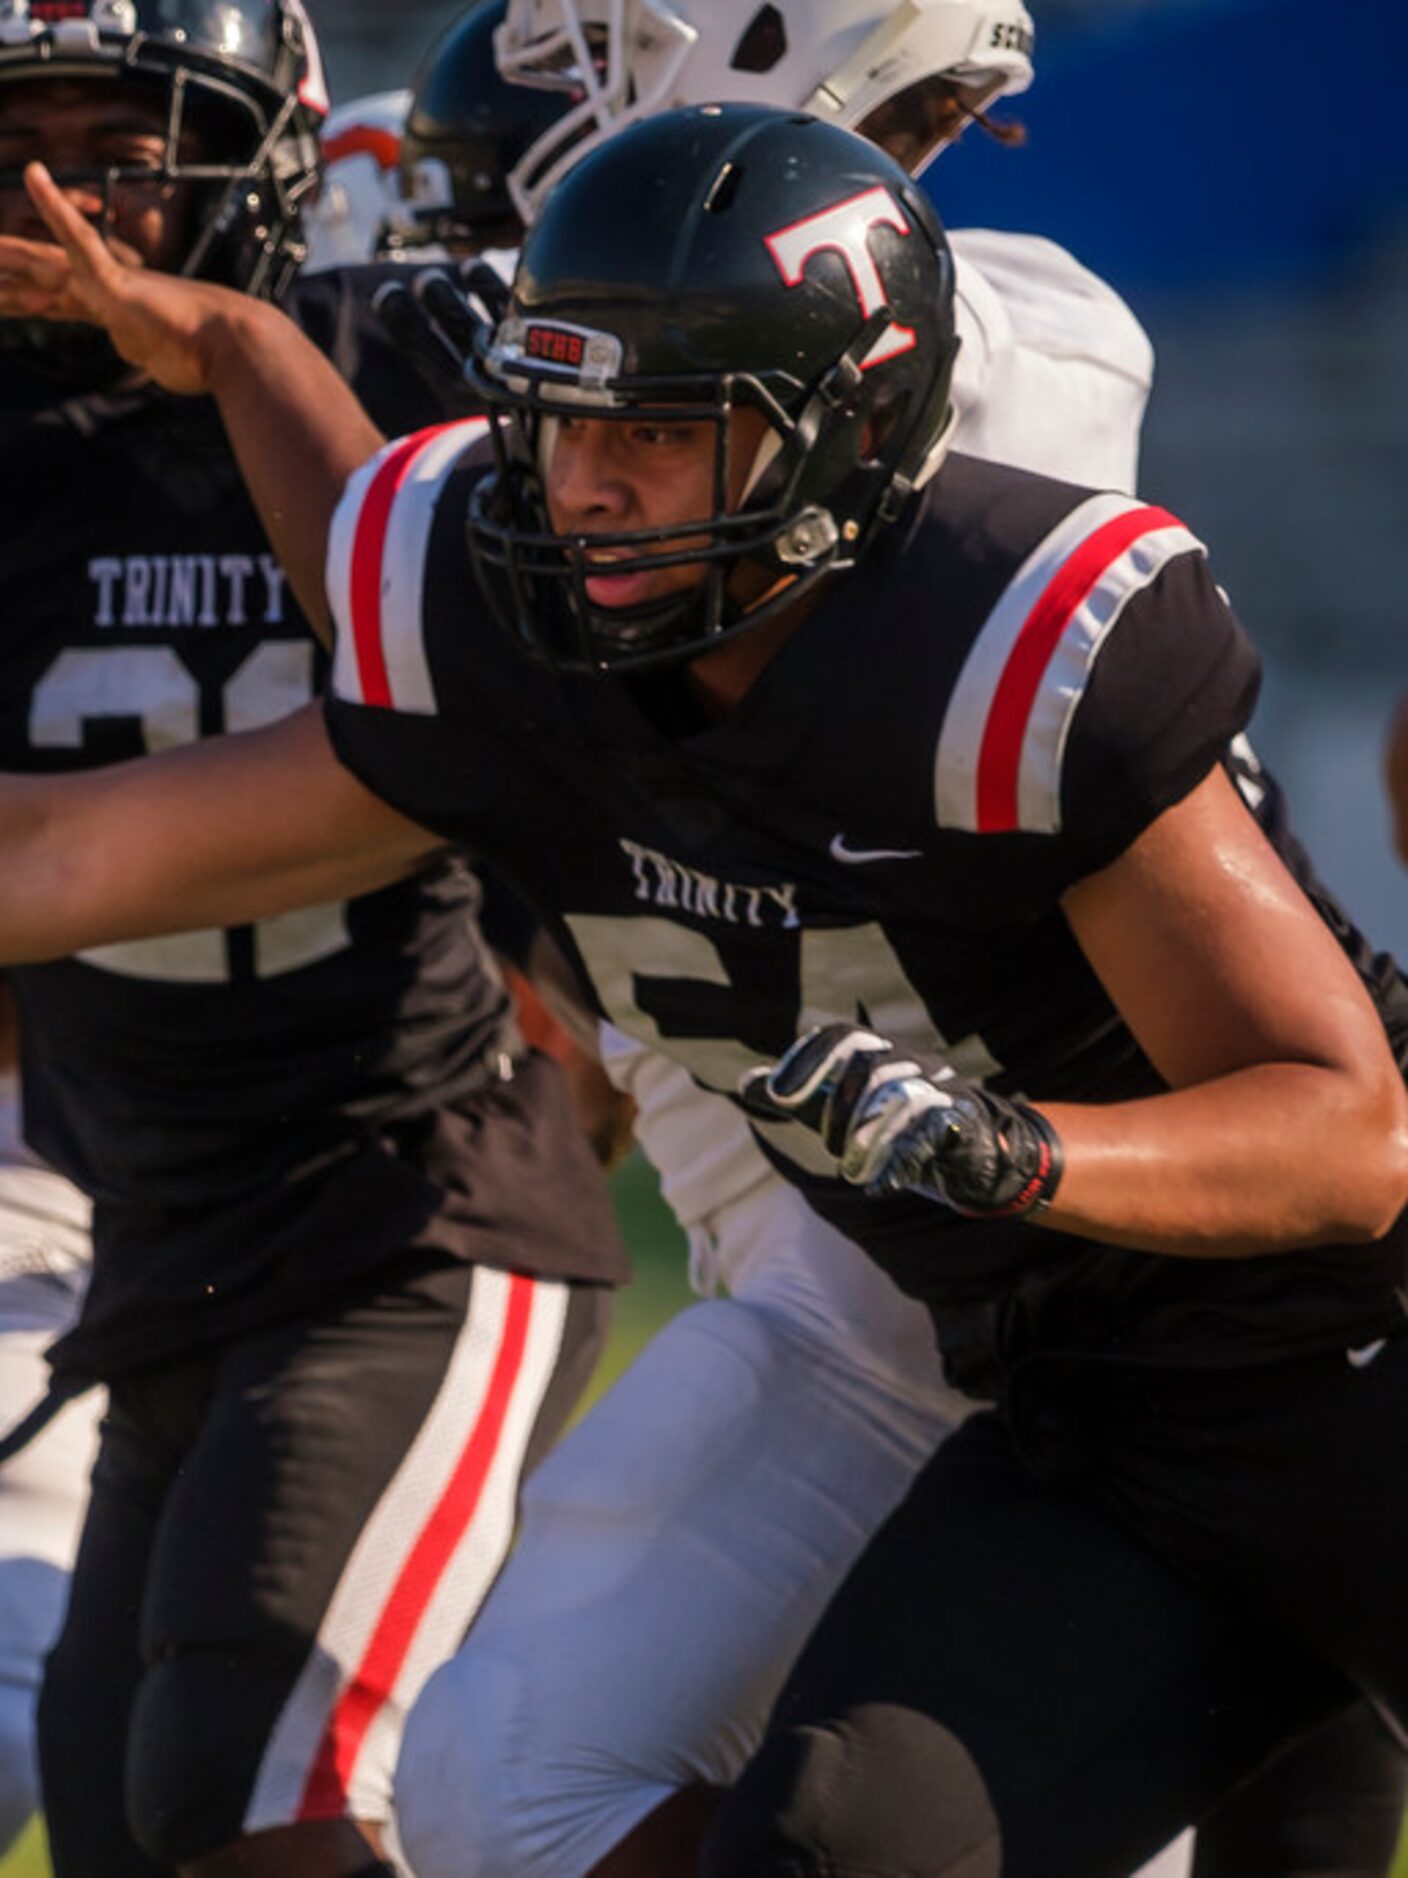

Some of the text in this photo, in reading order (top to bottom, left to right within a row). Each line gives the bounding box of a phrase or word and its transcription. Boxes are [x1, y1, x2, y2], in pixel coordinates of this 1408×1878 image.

[764, 186, 916, 370] T
[88, 553, 286, 627] TRINITY
[619, 837, 801, 930] TRINITY
